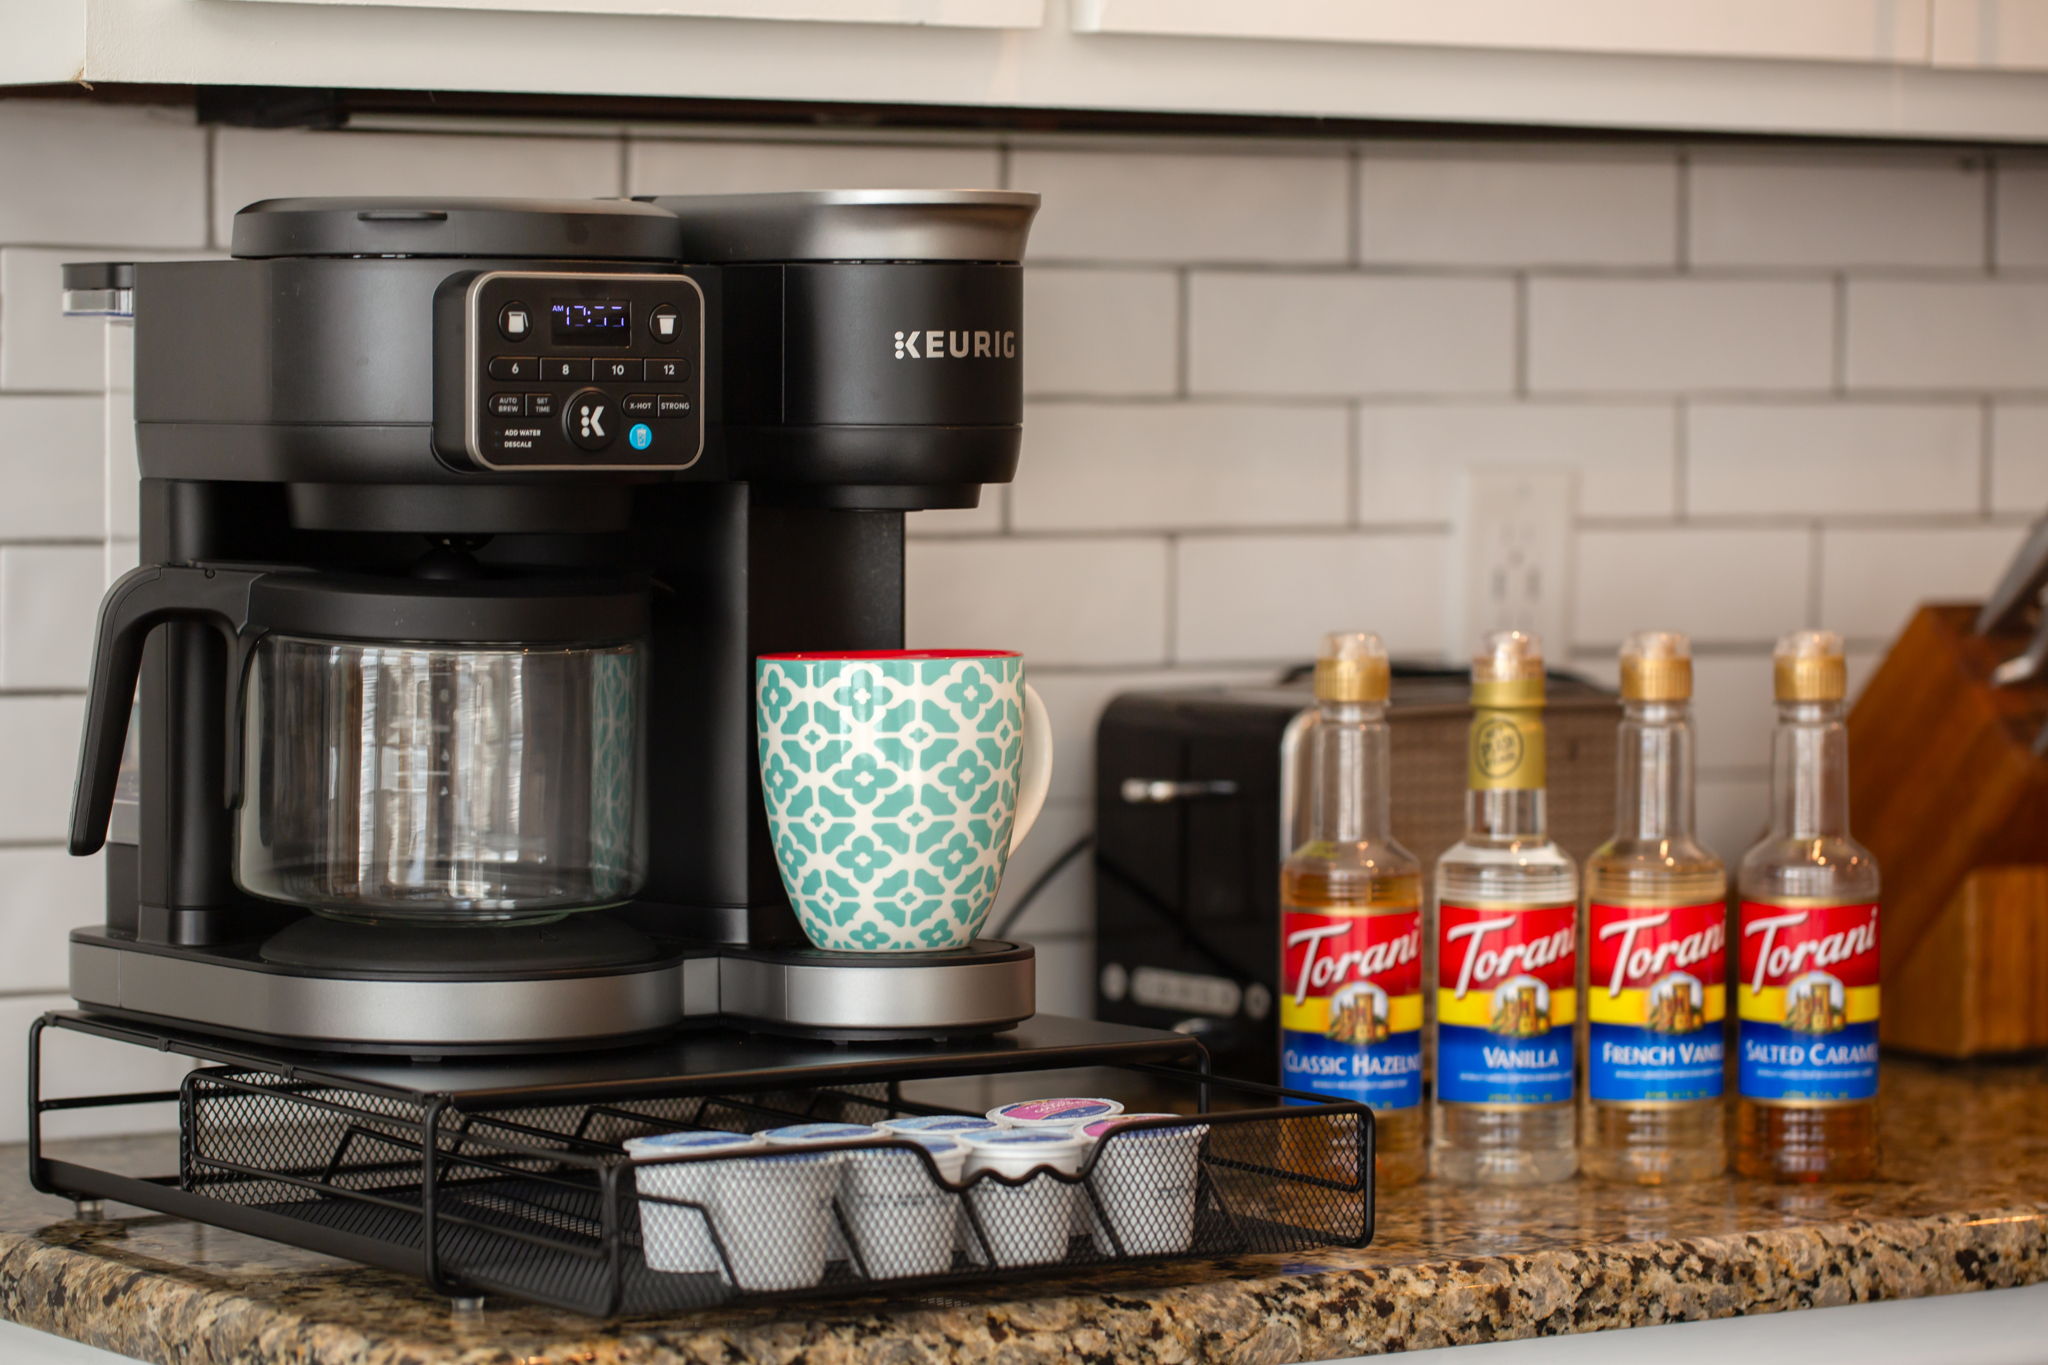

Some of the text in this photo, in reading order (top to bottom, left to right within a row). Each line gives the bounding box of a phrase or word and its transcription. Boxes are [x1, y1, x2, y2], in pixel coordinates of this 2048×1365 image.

[894, 330, 1015, 360] KEURIG
[511, 364, 520, 374] 6
[562, 364, 570, 375] 8
[611, 364, 625, 376] 10
[663, 364, 675, 376] 12
[498, 405, 519, 413] BREW
[535, 405, 551, 413] TIME
[629, 402, 652, 410] X-HOT
[660, 402, 690, 410] STRONG
[504, 429, 541, 437] ADD WATER
[504, 440, 532, 448] DESCALE
[1744, 906, 1878, 994] Torani
[1287, 916, 1421, 1006] Torani
[1482, 1046, 1560, 1069] VANILLA
[1602, 1042, 1676, 1067] FRENCH
[1745, 1039, 1805, 1066] SALTED
[1284, 1050, 1348, 1076] CLASSIC
